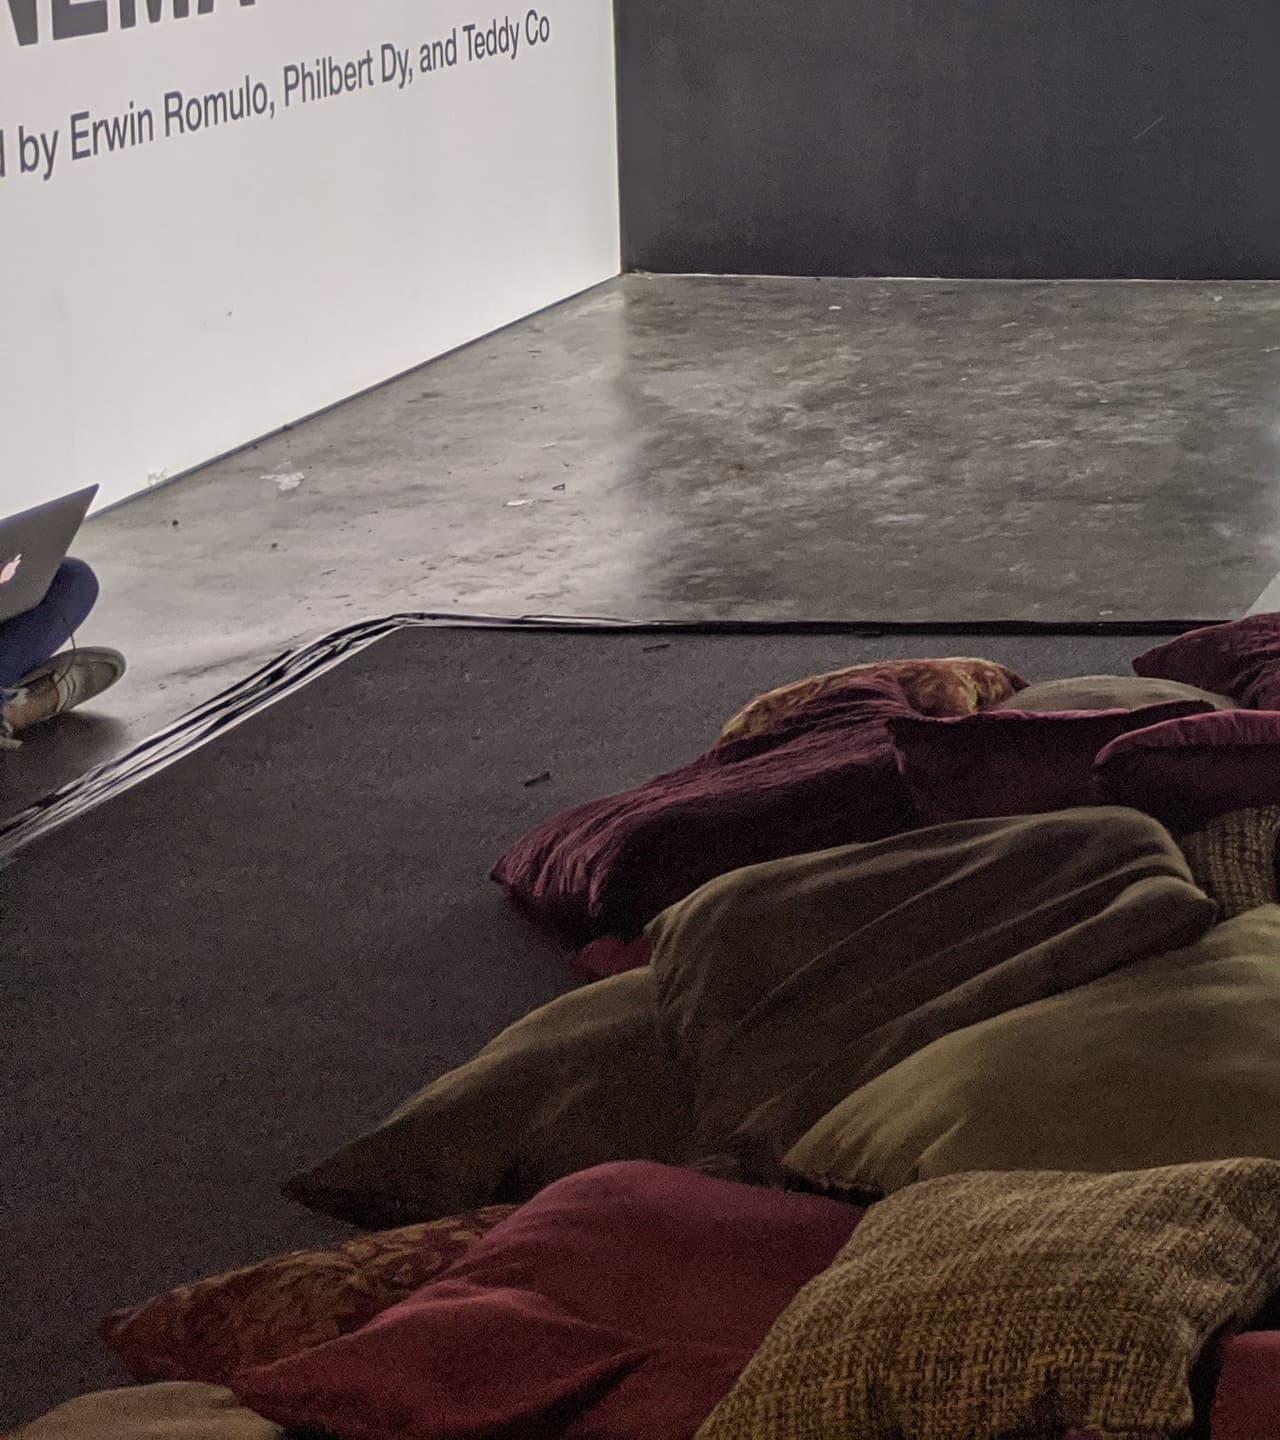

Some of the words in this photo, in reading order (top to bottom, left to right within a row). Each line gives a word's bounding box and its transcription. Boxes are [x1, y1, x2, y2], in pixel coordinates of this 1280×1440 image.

[18, 124, 60, 181] by
[70, 100, 155, 161] Erwin
[164, 81, 276, 137] Romulo,
[282, 47, 375, 107] Philbert
[380, 42, 414, 89] Dy,
[418, 28, 458, 74] and
[461, 14, 522, 62] Teddy
[525, 9, 551, 46] Co
